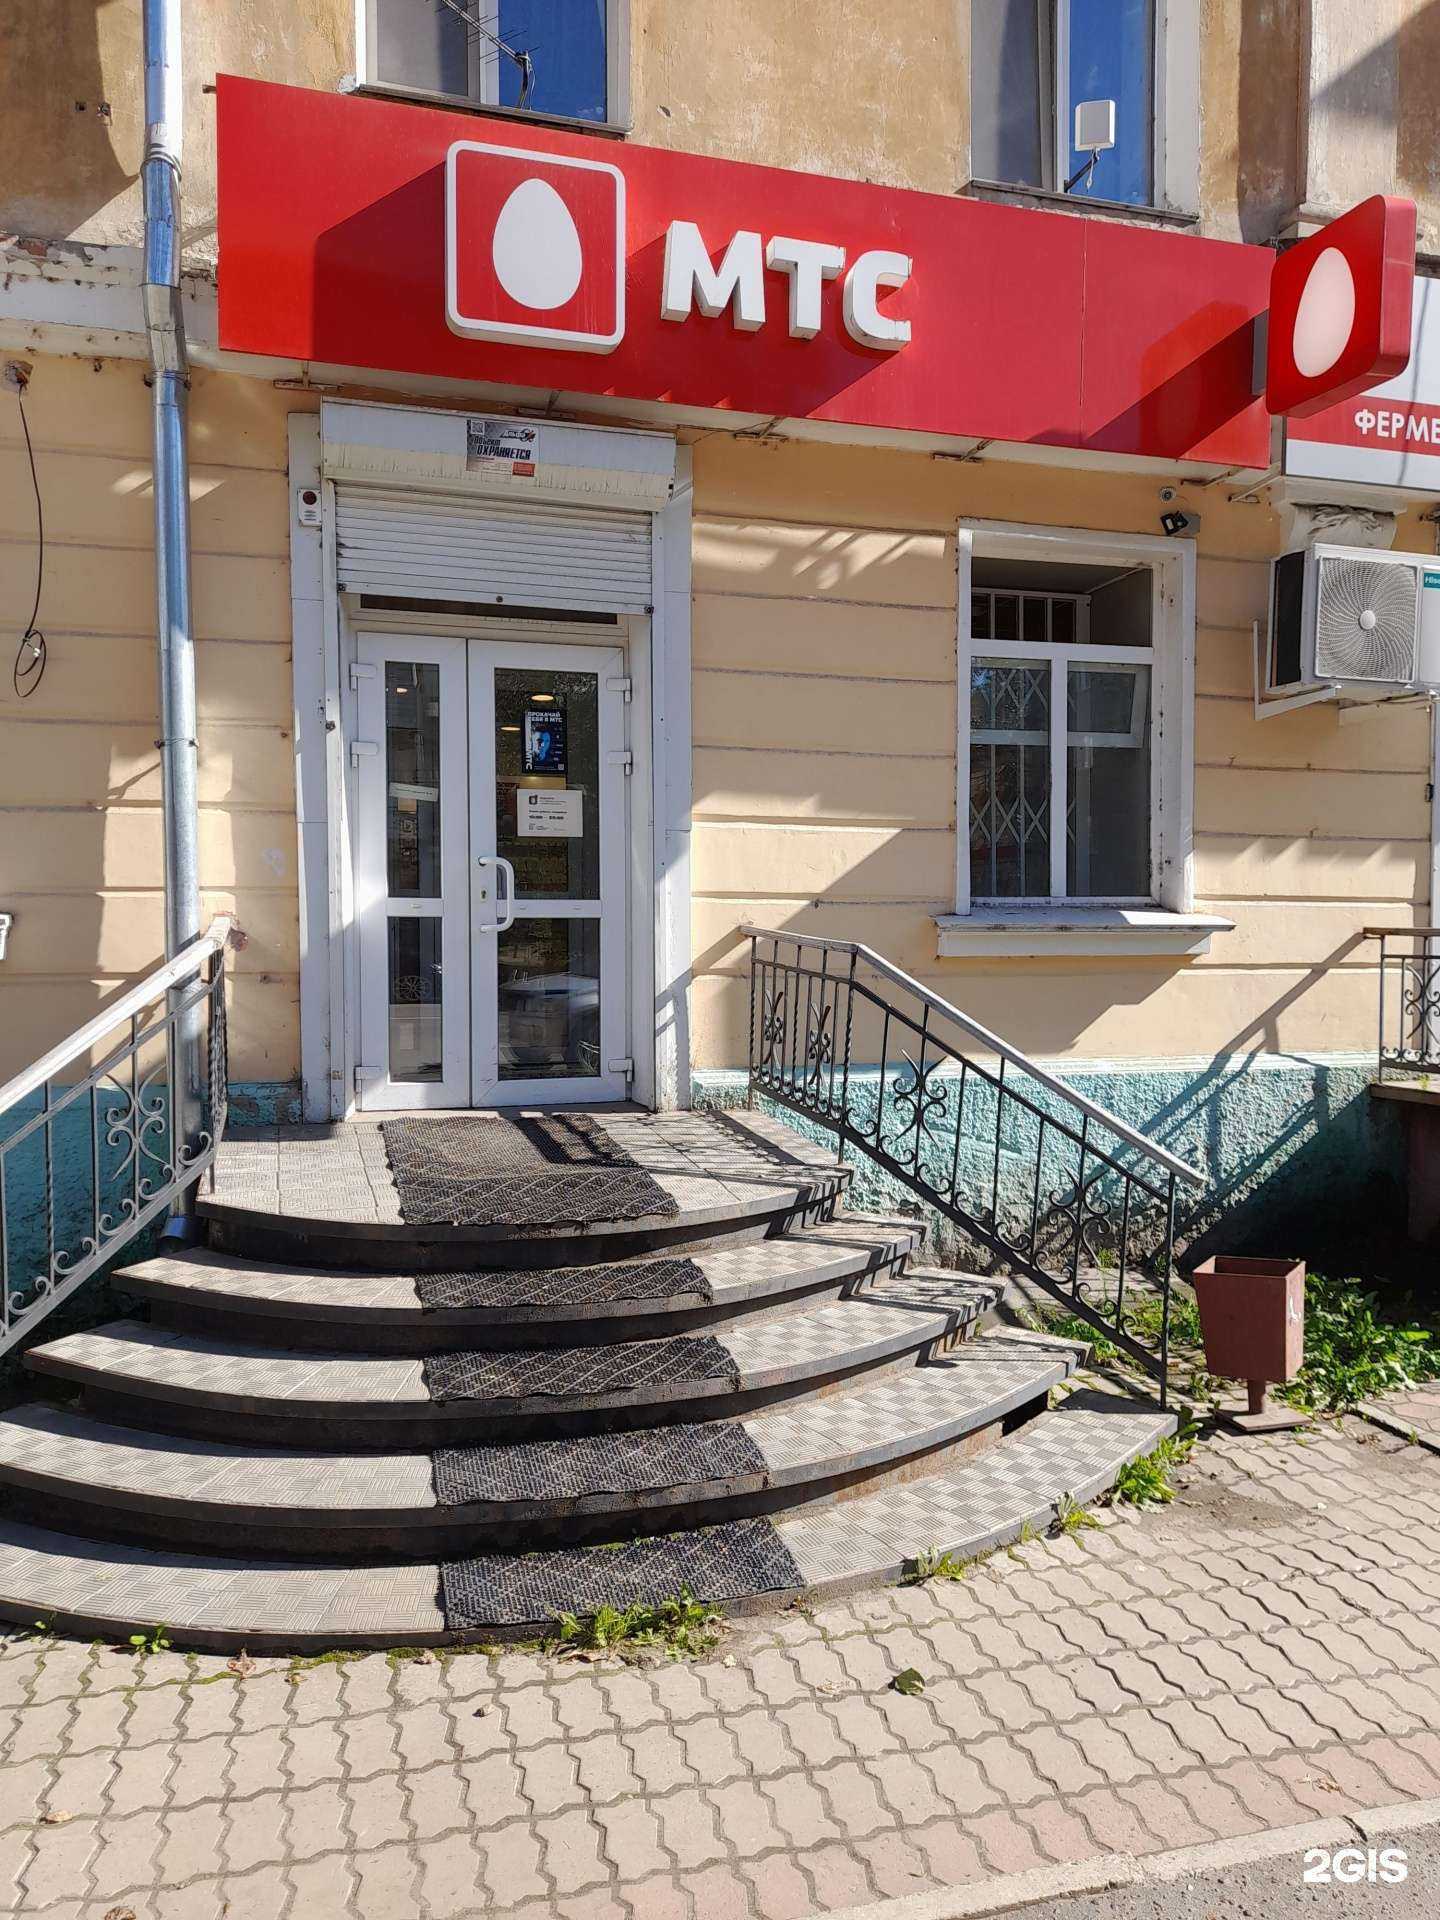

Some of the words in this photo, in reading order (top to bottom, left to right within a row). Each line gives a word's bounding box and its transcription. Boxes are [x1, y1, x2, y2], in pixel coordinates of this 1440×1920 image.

[661, 220, 913, 351] МТС
[1354, 408, 1440, 444] ФЕРМЕ
[476, 445, 531, 460] ОХРАНЯЕТСЯ
